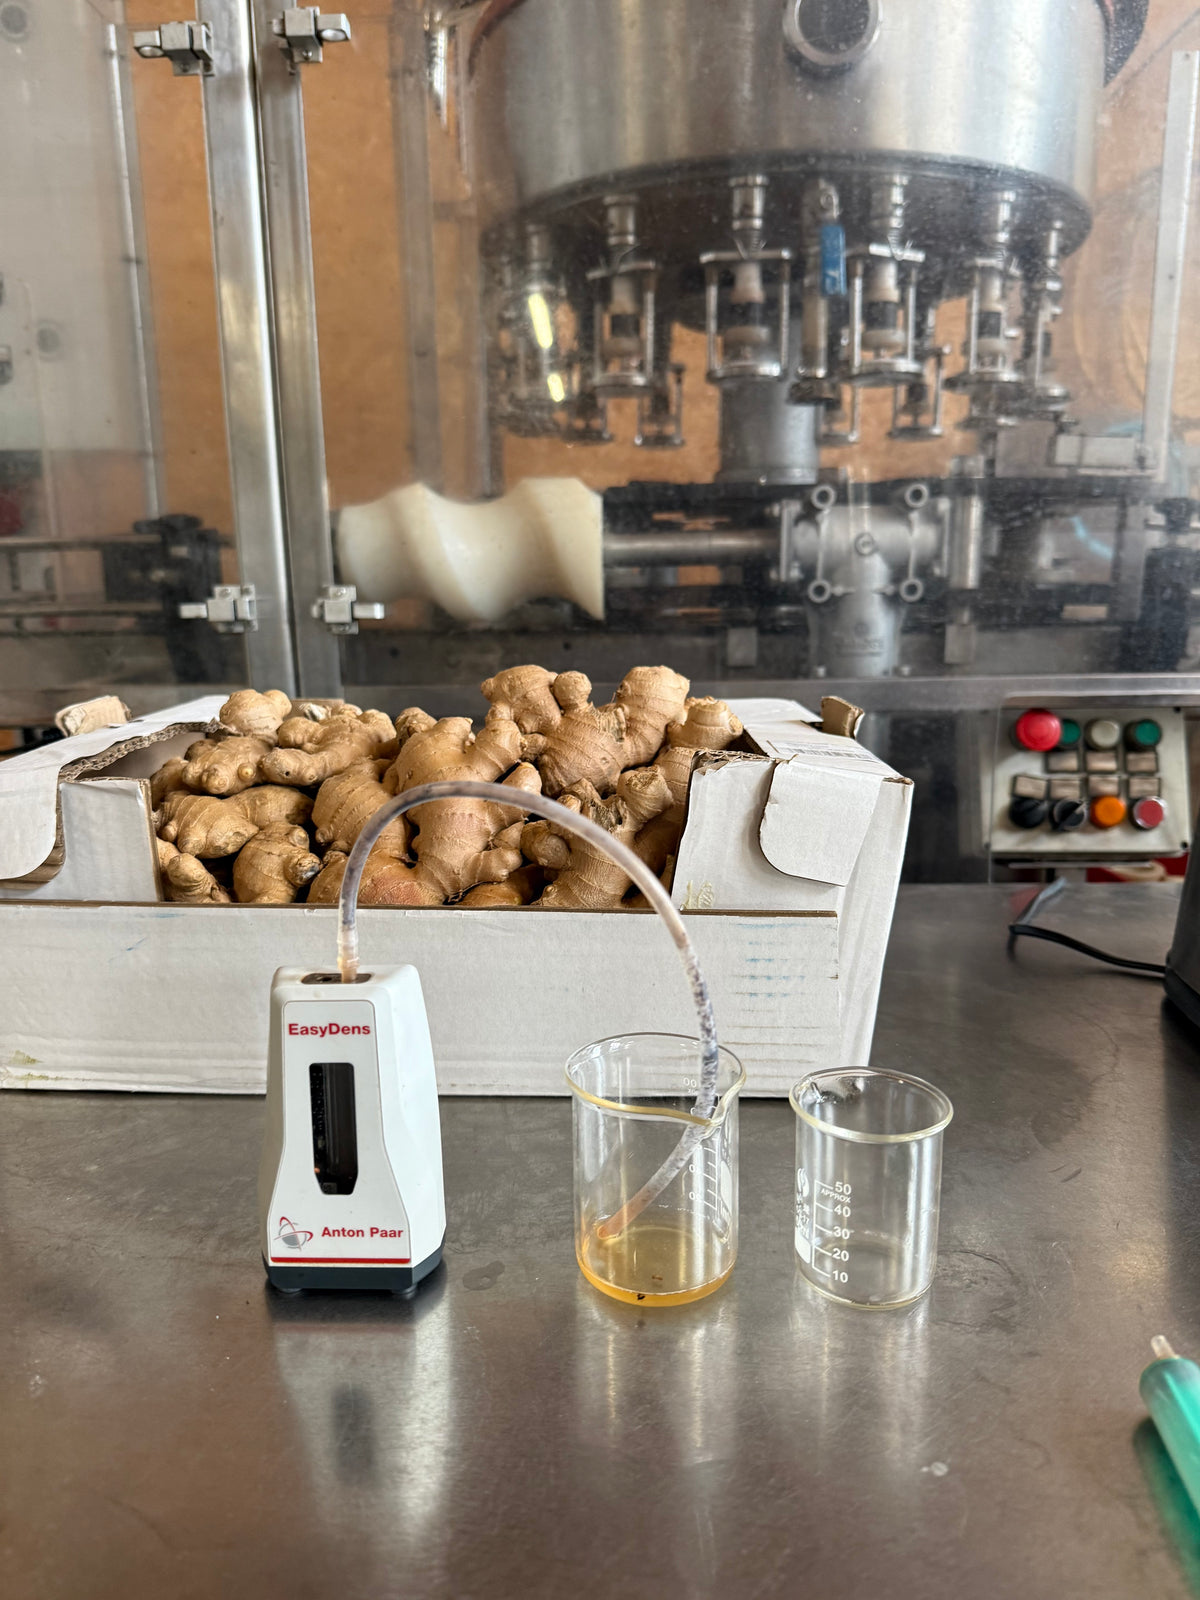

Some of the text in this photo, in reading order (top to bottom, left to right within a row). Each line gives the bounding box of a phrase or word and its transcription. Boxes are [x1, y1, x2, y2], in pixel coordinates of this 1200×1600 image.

[288, 1022, 371, 1038] EasyDens
[820, 1187, 852, 1204] APPROX
[834, 1181, 852, 1196] 50
[833, 1204, 851, 1218] 40
[321, 1226, 404, 1238] Anton Paar
[833, 1225, 850, 1240] 30
[832, 1247, 850, 1262] 20
[832, 1269, 849, 1284] 10
